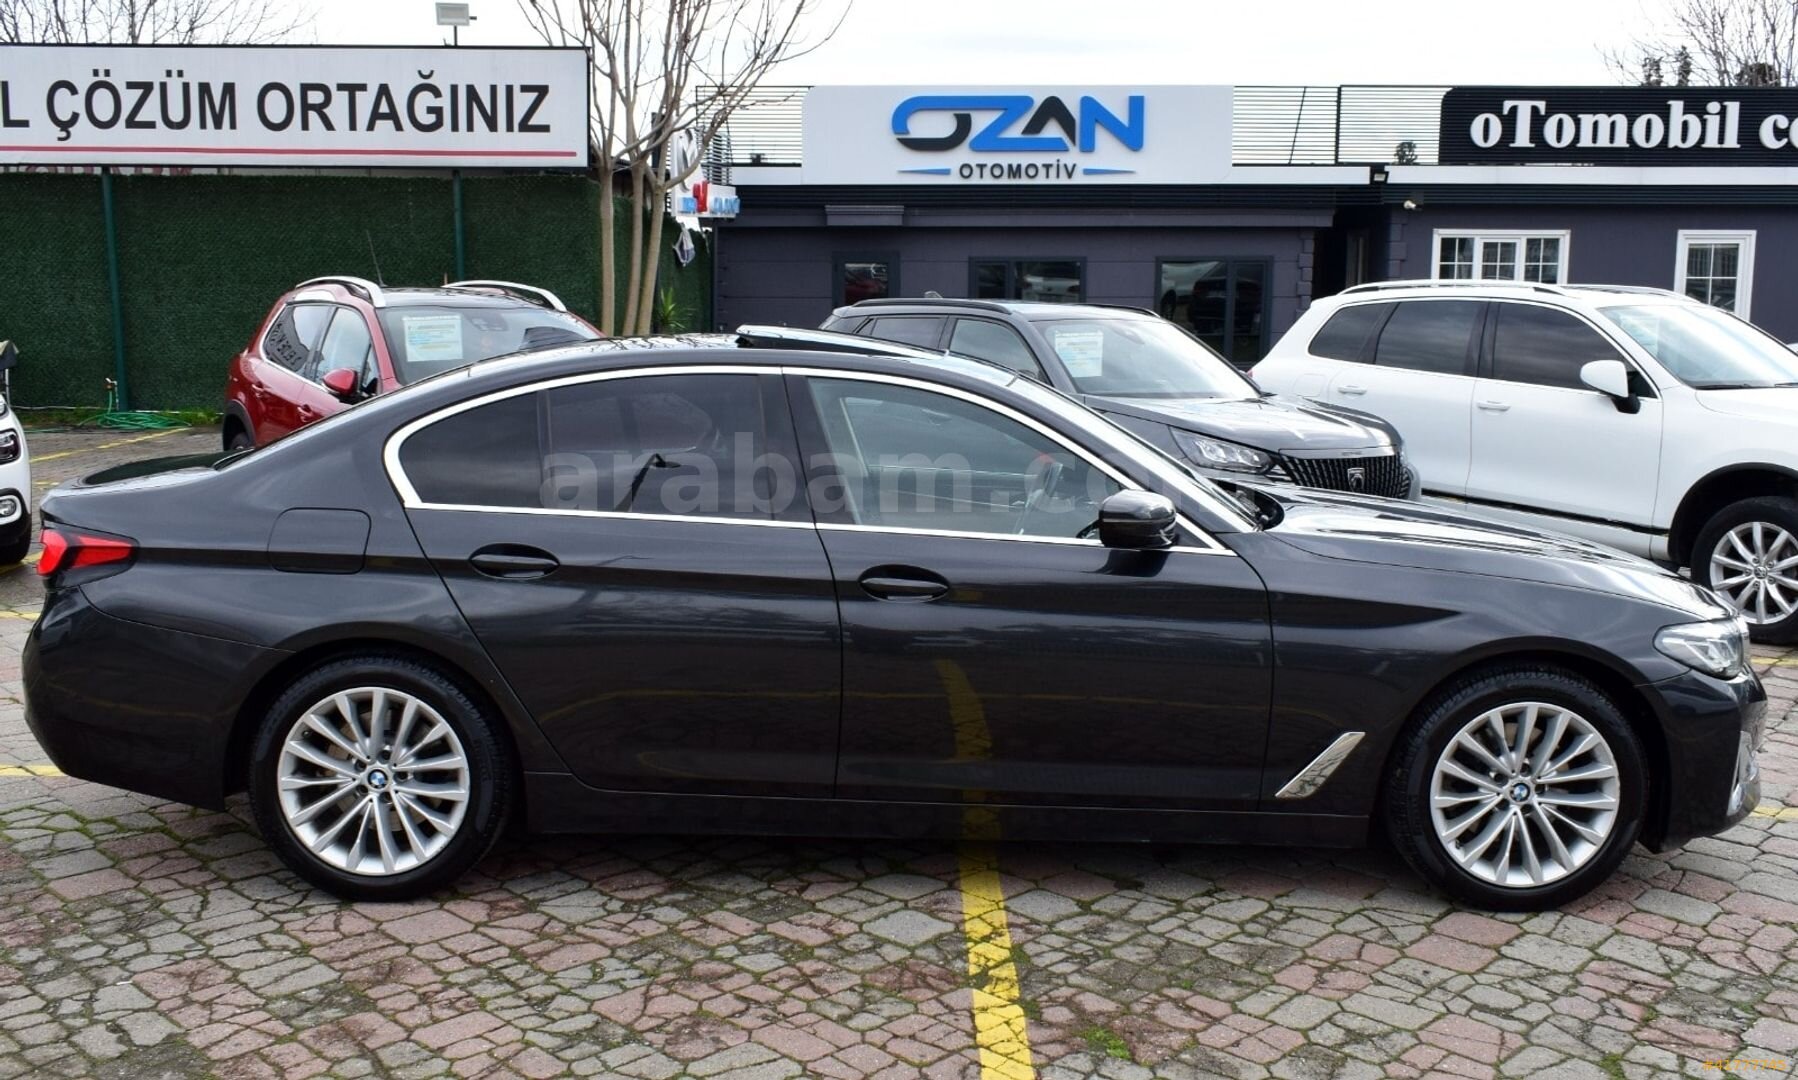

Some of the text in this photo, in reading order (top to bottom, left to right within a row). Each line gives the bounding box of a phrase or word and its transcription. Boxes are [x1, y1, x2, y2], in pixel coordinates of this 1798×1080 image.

[45, 69, 237, 141] ÇÖZÜM
[256, 69, 551, 132] ORTAĞINIZ
[891, 95, 1145, 152] OZAN
[1470, 100, 1741, 149] oTomobil
[959, 159, 1077, 180] OTOMOTİV
